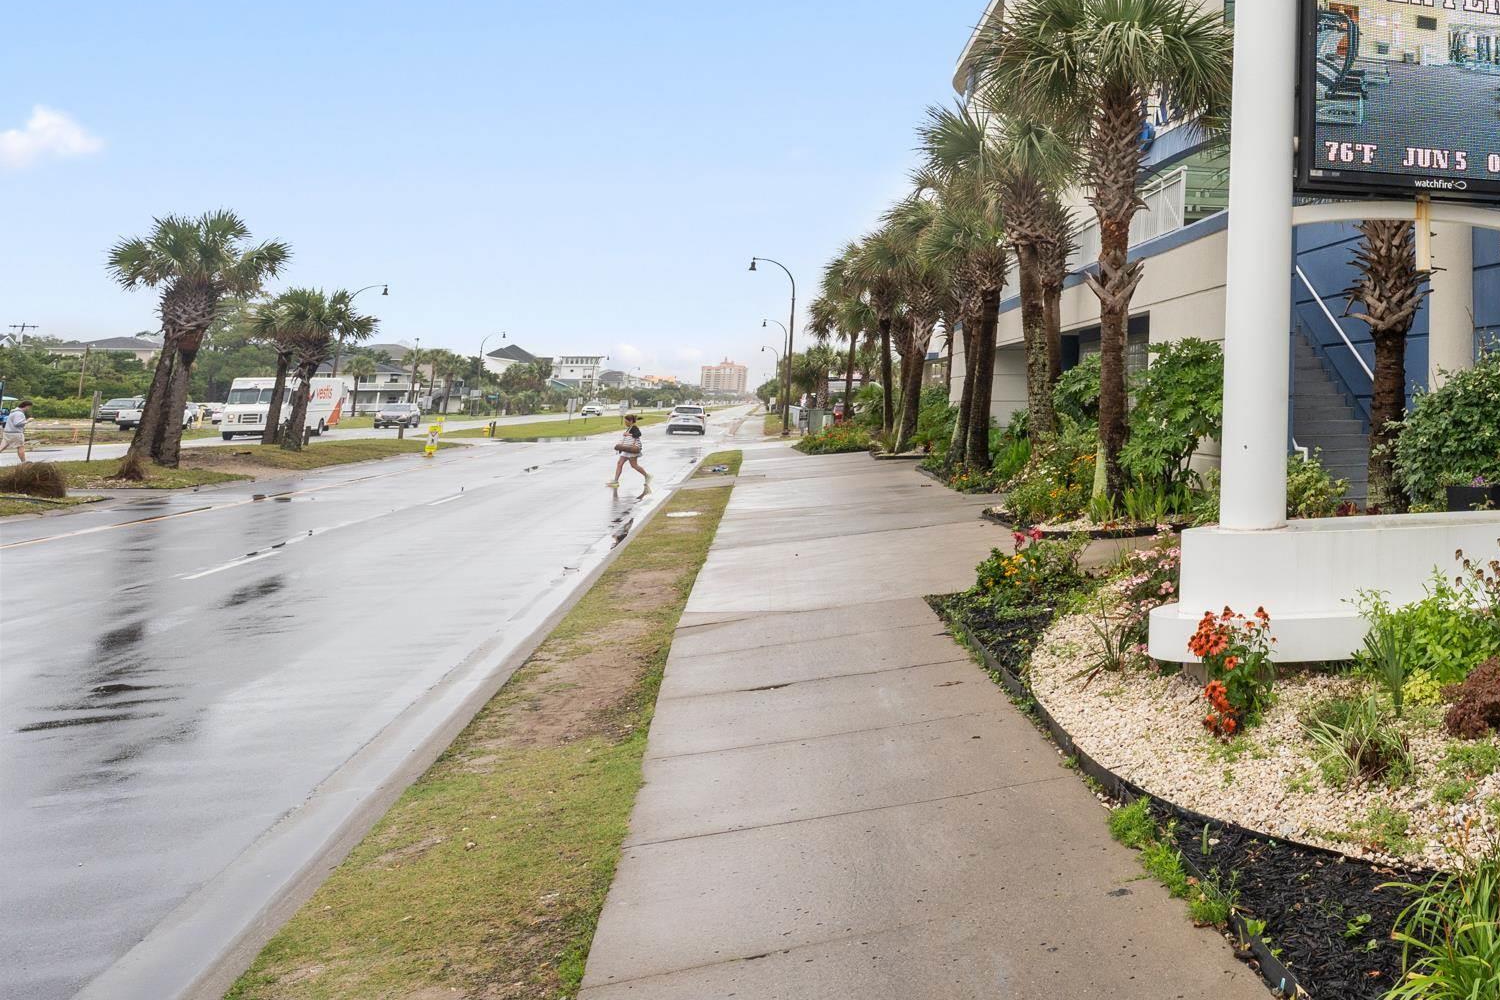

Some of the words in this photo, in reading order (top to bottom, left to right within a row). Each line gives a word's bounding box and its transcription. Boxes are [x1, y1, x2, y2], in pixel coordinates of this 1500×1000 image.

[1403, 147, 1450, 170] JUN
[1454, 151, 1467, 171] 5
[1414, 179, 1453, 189] watchfire
